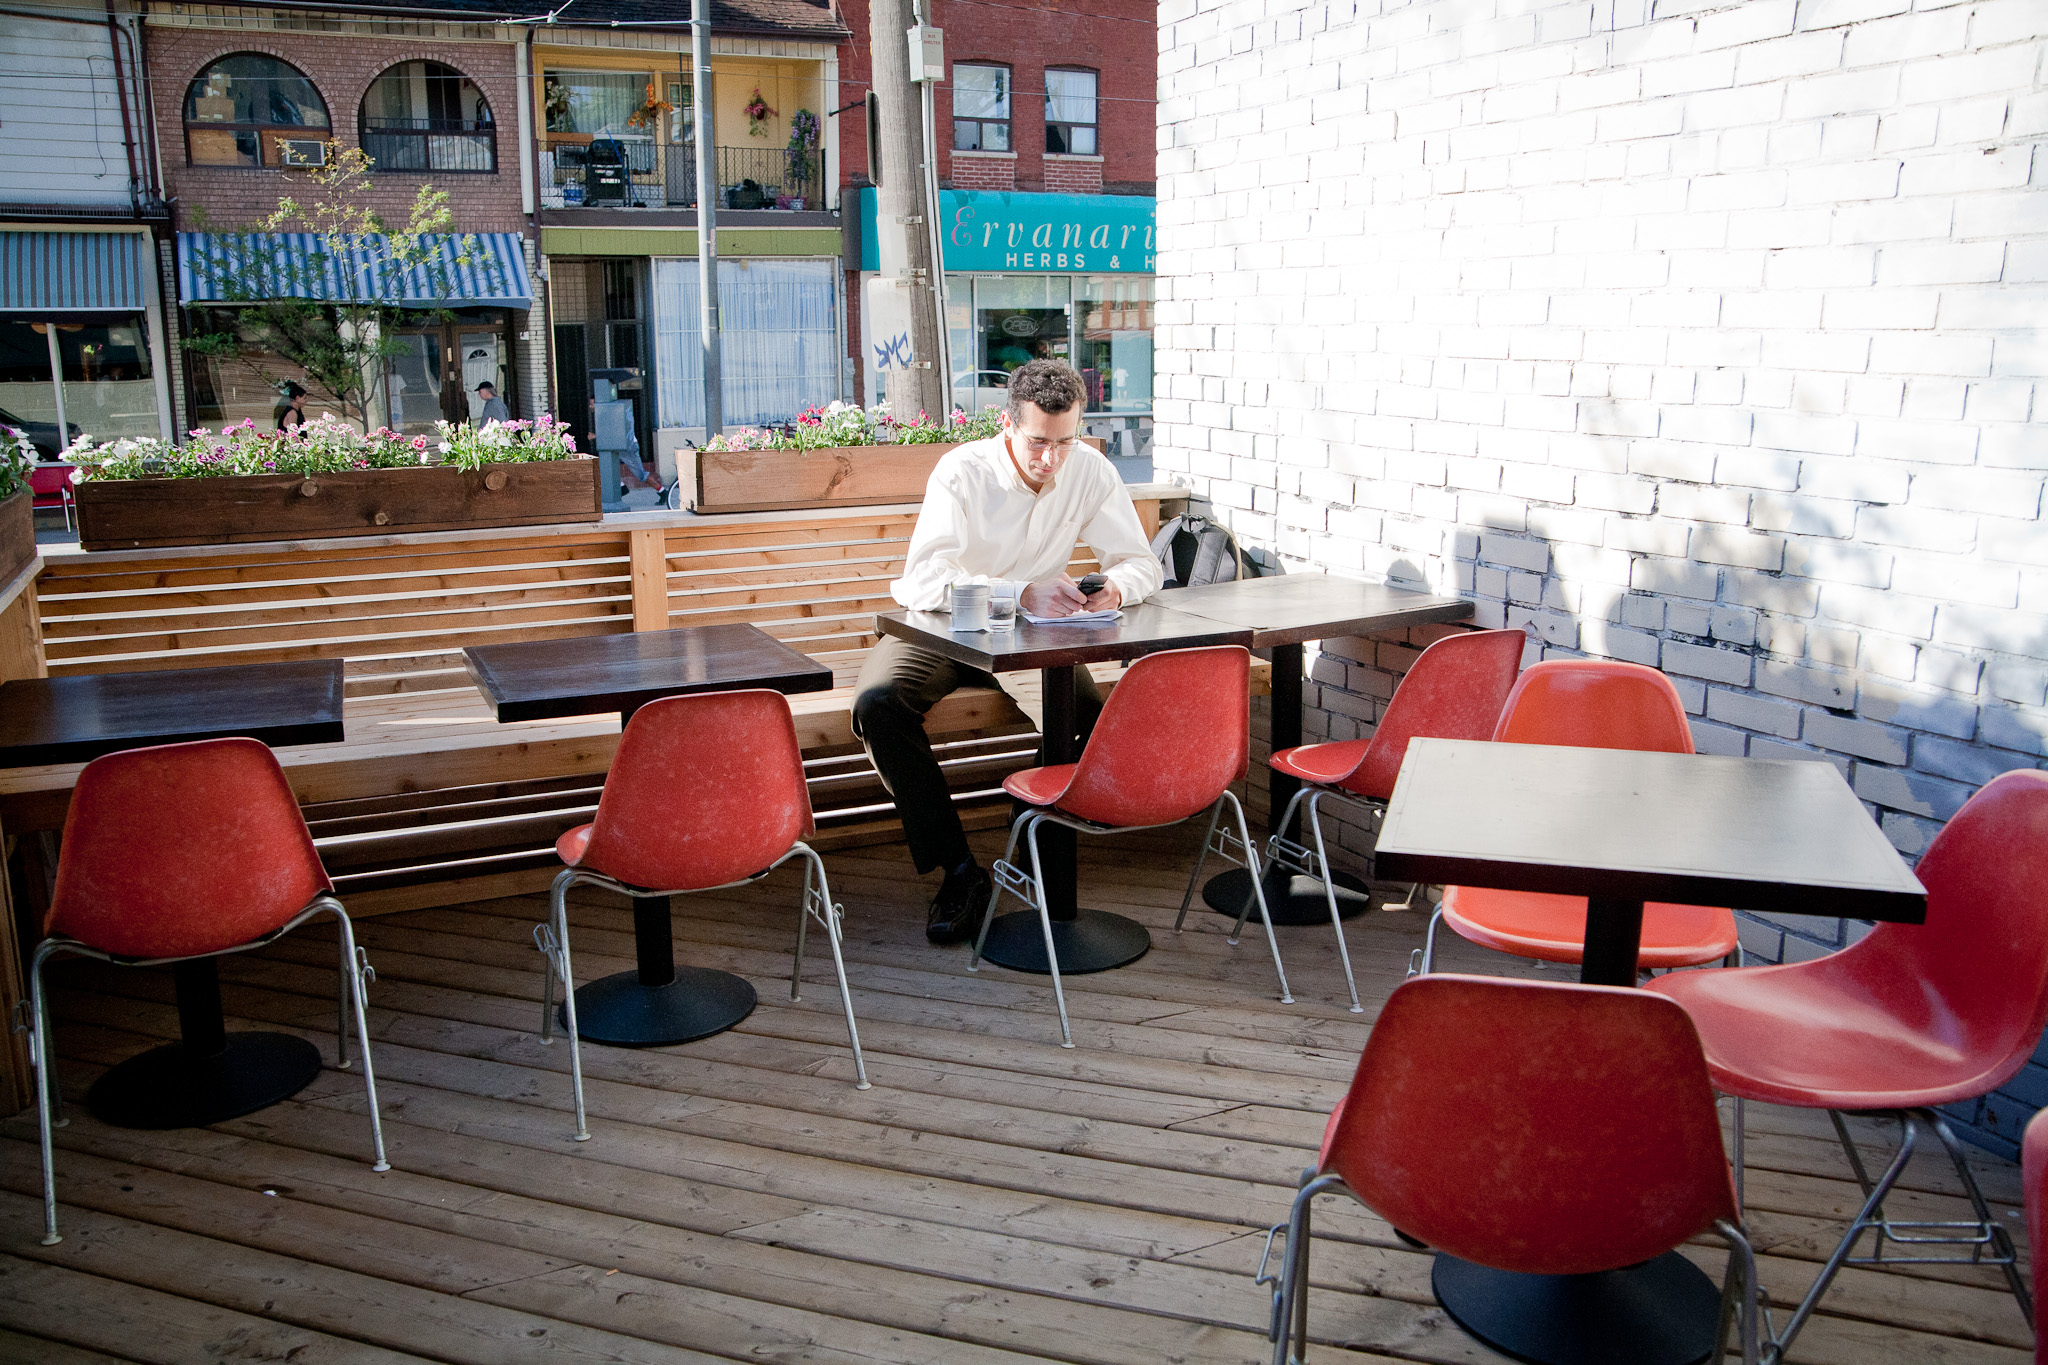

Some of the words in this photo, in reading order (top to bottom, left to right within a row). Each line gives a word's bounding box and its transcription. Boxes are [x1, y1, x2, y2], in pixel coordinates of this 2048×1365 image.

[1006, 252, 1086, 269] HERBS
[1109, 254, 1120, 269] &
[1004, 319, 1037, 331] OPEN
